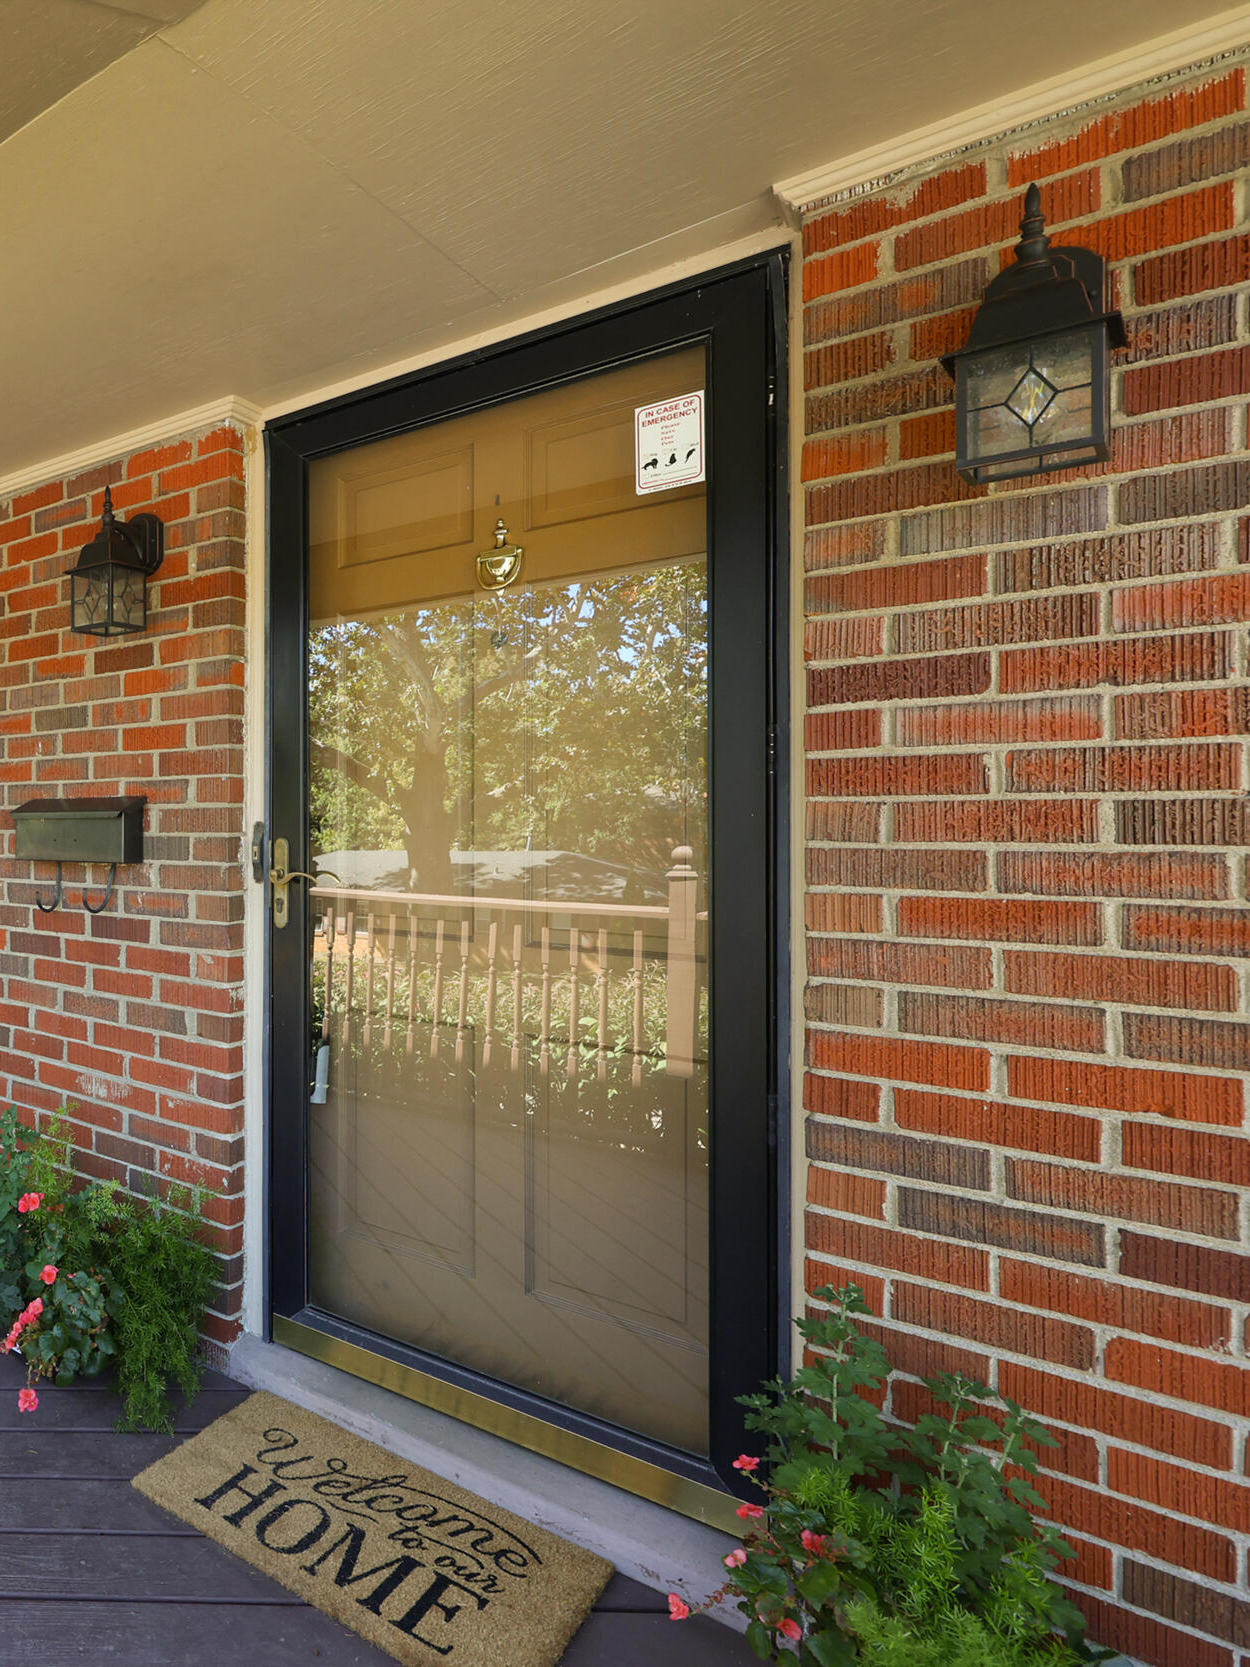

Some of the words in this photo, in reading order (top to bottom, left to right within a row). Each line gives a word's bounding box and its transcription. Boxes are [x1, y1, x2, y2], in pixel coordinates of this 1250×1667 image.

[641, 407, 698, 428] EMERGENCY
[645, 410, 655, 418] IN
[656, 403, 680, 415] CASE
[682, 399, 695, 408] OF
[256, 1427, 543, 1579] Welcome
[193, 1463, 490, 1656] HOME
[388, 1522, 431, 1552] to
[434, 1553, 506, 1595] our
